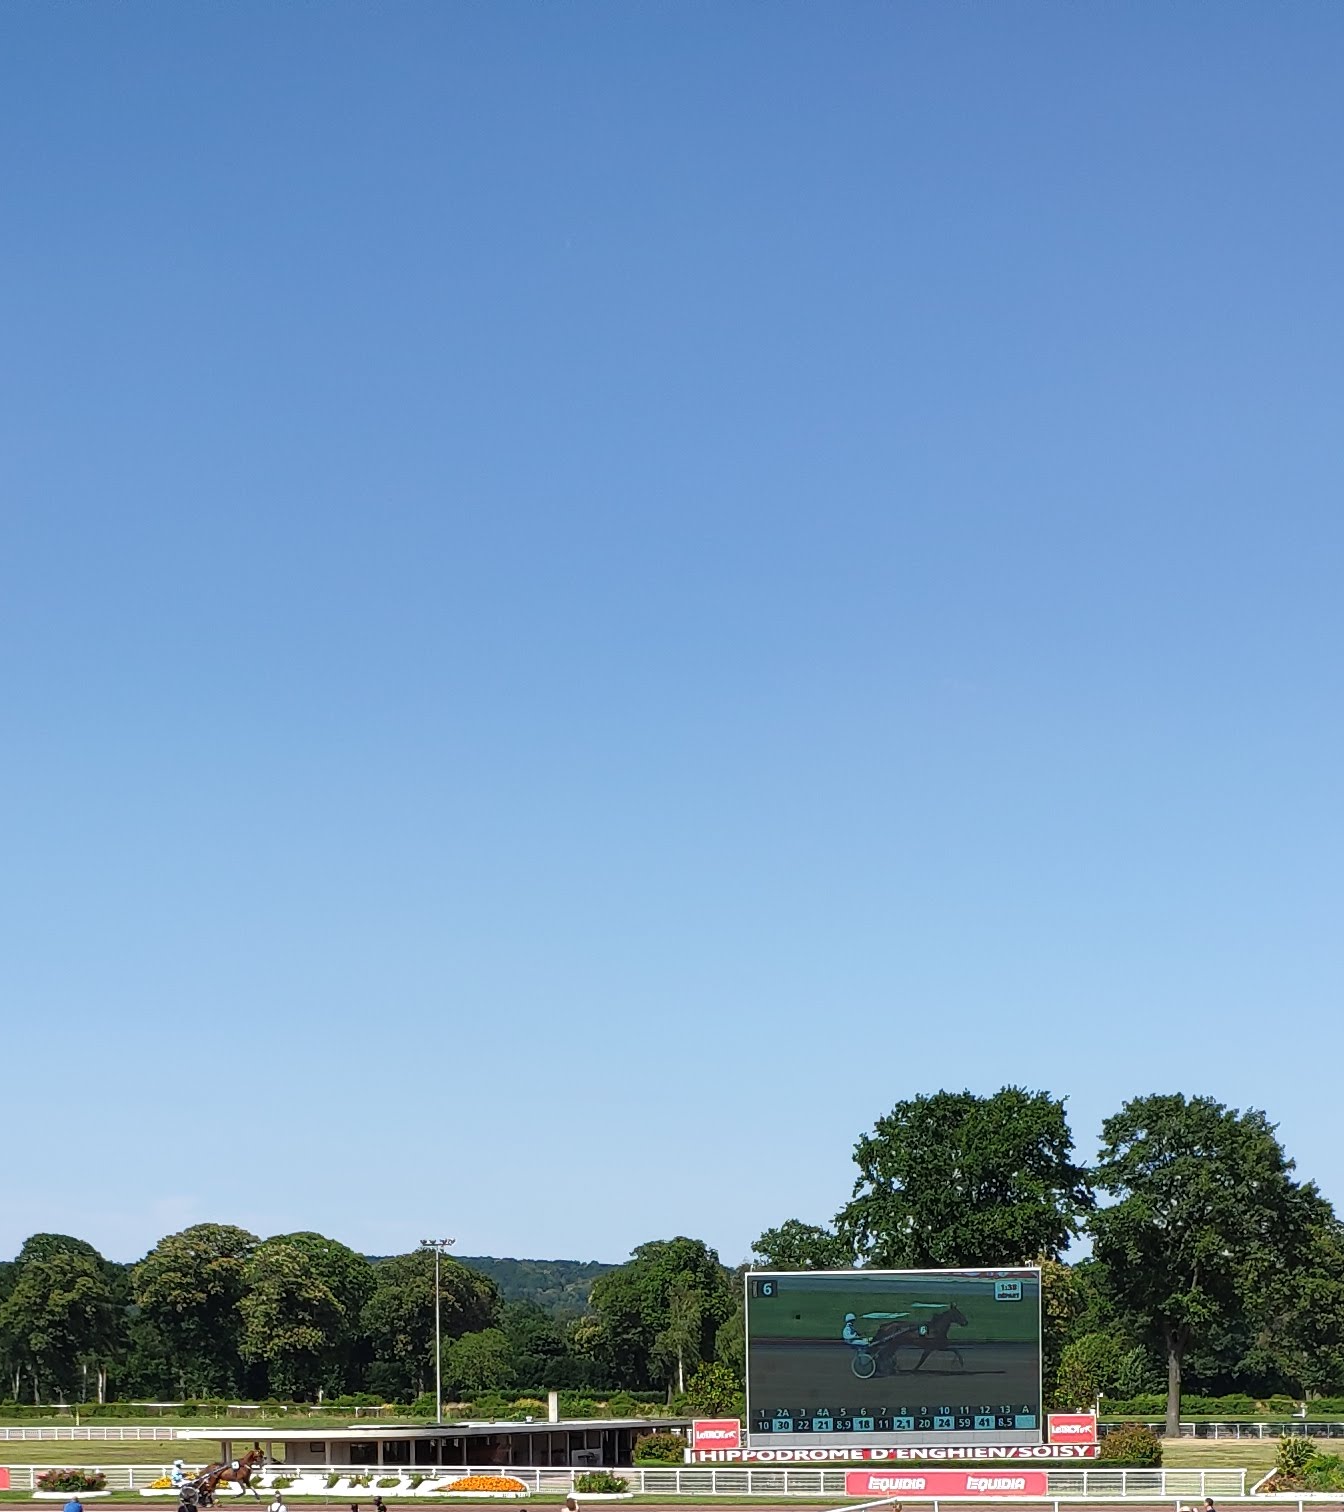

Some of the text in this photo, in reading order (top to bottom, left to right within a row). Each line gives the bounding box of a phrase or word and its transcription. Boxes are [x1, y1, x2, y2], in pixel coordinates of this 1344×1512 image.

[761, 1283, 773, 1295] 6
[760, 1410, 765, 1418] 1
[777, 1409, 789, 1417] 2A
[800, 1409, 806, 1417] 3
[817, 1408, 829, 1417] 4A
[840, 1408, 846, 1416] 5
[861, 1408, 866, 1416] 6
[901, 1407, 907, 1415] 8
[960, 1406, 970, 1414] 11
[980, 1406, 991, 1414] 12
[1022, 1405, 1029, 1413] A
[758, 1421, 770, 1430] 10
[777, 1421, 789, 1430] 30
[798, 1421, 810, 1429] 22
[817, 1421, 829, 1429] 21
[878, 1420, 889, 1429] 11
[919, 1419, 931, 1428] 20
[939, 1418, 950, 1428] 24
[959, 1418, 971, 1427] 59
[979, 1418, 990, 1427] 41
[700, 1446, 1090, 1462] HIPPODROME D'ENGHIEN/SOISY
[867, 1476, 926, 1491] EQUIDIA
[966, 1475, 1026, 1491] EQUIDIA
